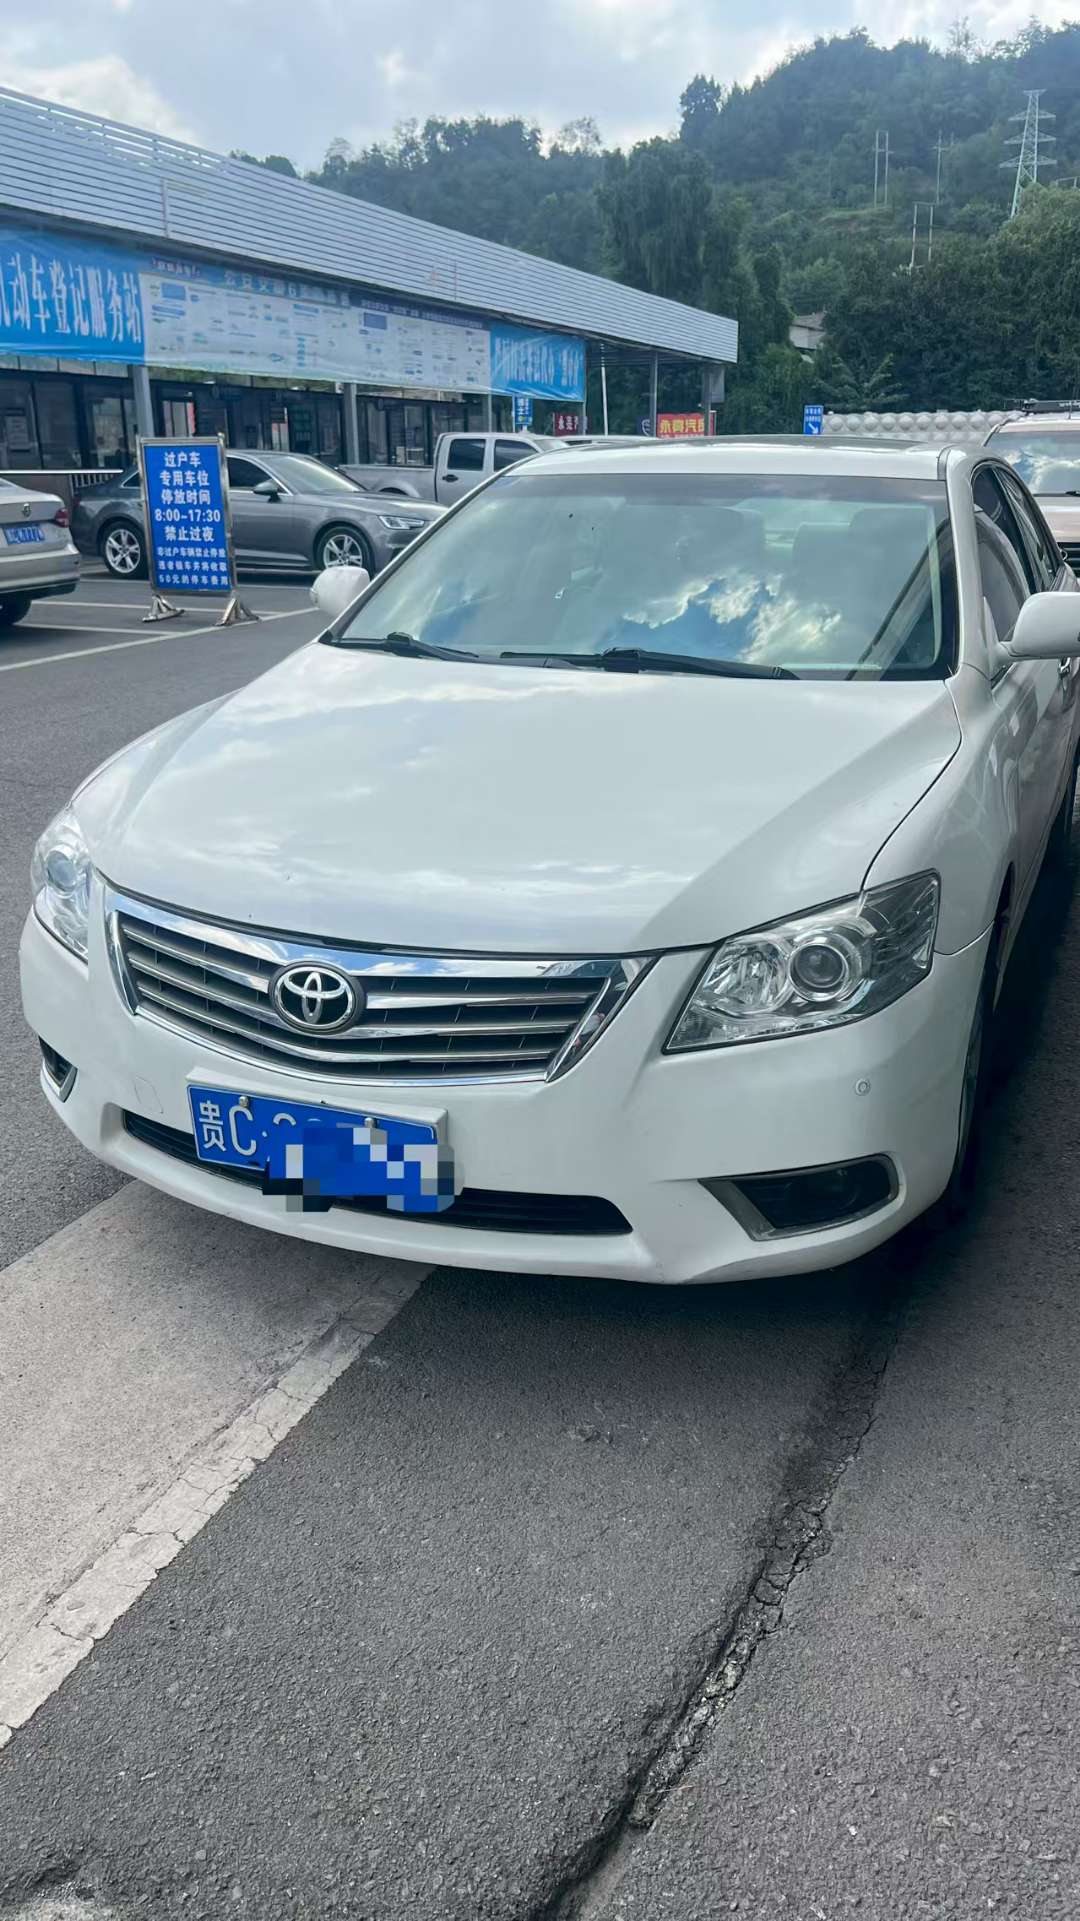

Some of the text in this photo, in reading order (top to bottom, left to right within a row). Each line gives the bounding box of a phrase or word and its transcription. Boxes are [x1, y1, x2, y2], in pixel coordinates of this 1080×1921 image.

[164, 451, 201, 468] 过户车
[160, 470, 210, 487] 专用车位
[161, 489, 211, 505] 停放时间
[155, 508, 221, 522] 8:00-17:30
[165, 526, 215, 542] 禁止过夜
